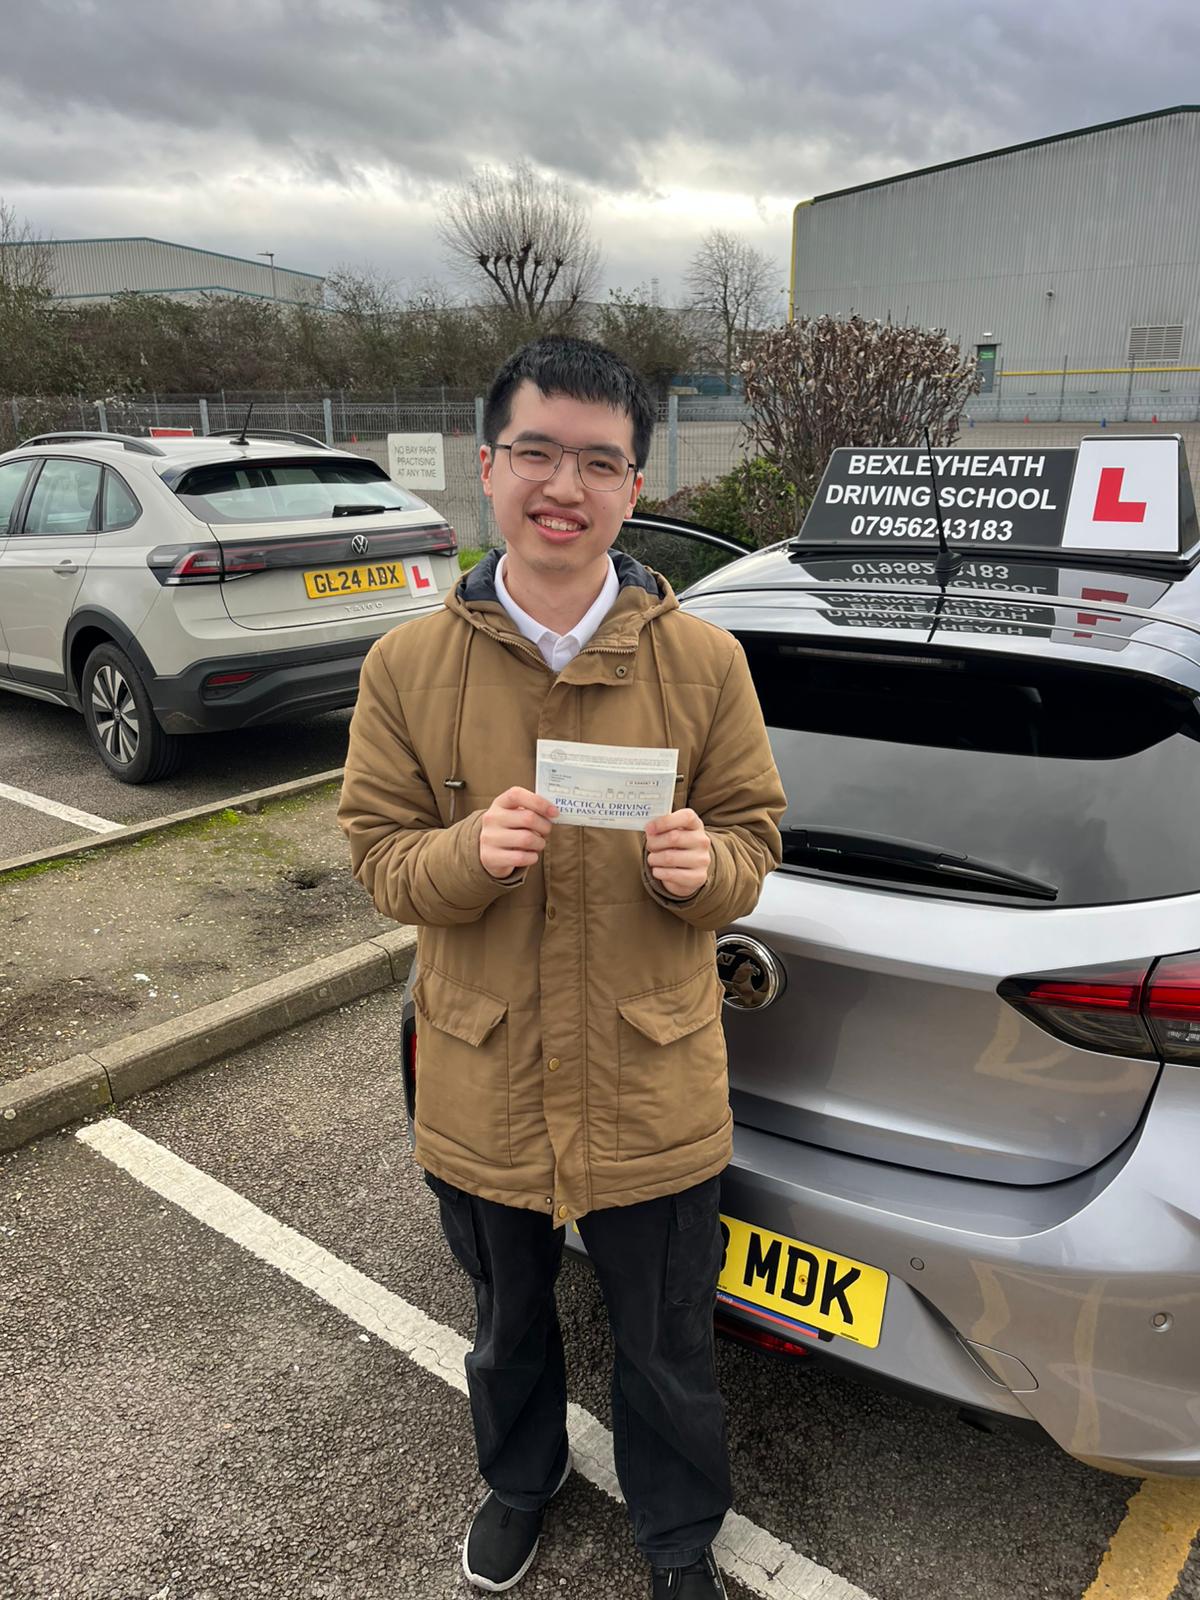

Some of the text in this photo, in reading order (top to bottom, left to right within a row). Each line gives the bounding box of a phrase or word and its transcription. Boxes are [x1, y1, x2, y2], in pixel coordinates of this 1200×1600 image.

[394, 446, 437, 455] NO BAY PARK
[397, 457, 436, 466] PRACTISING
[407, 469, 418, 477] ANY
[420, 469, 437, 477] TIME
[848, 455, 1045, 477] BEXLEYHEATH
[825, 484, 1057, 510] DRIVING SCHOOL
[1092, 467, 1147, 523] L
[850, 515, 1013, 541] 07956243183
[313, 568, 361, 593] GL24
[411, 565, 430, 588] L
[554, 798, 651, 811] PRACTICAL DRIVING
[743, 1231, 861, 1325] MDK
